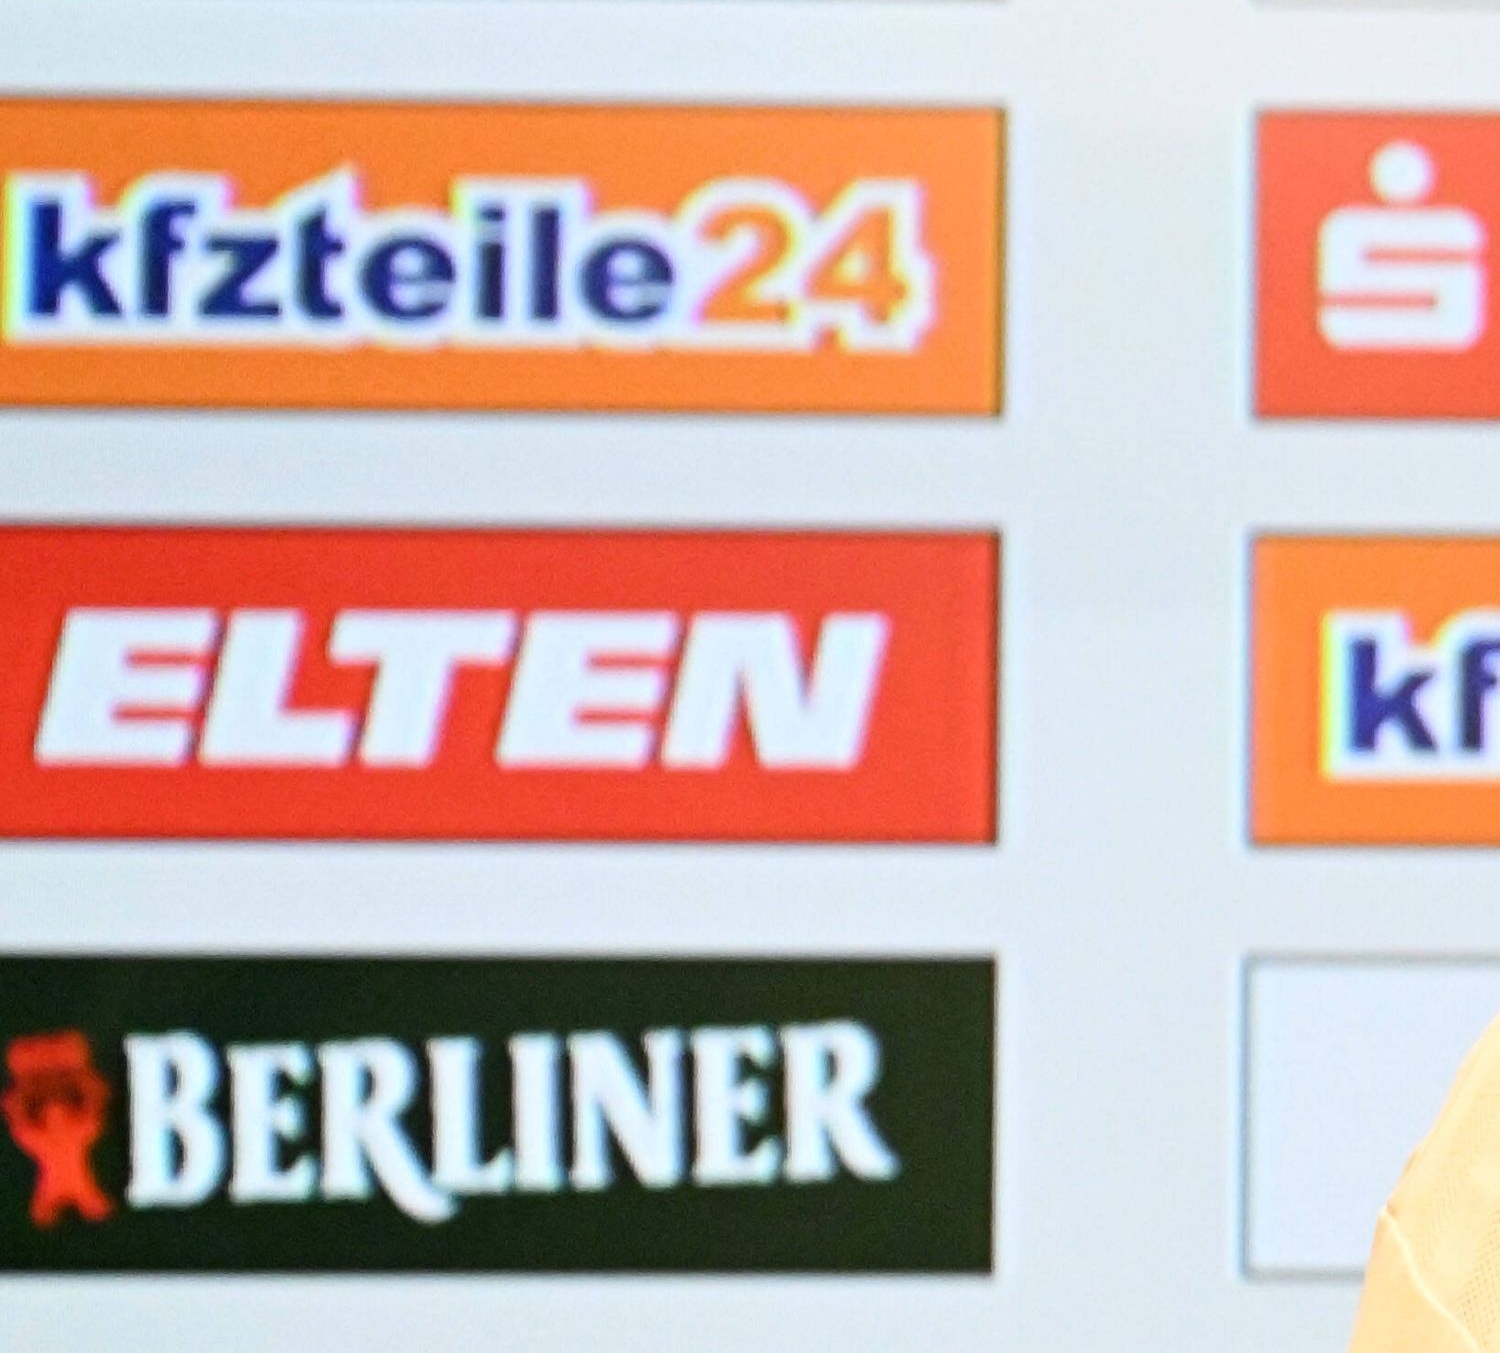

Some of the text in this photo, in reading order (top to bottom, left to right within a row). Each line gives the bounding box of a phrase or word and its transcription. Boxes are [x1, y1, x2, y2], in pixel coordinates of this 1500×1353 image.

[22, 195, 908, 327] kfzteile24
[33, 606, 890, 770] ELTEN
[123, 1018, 898, 1223] BERLINER
